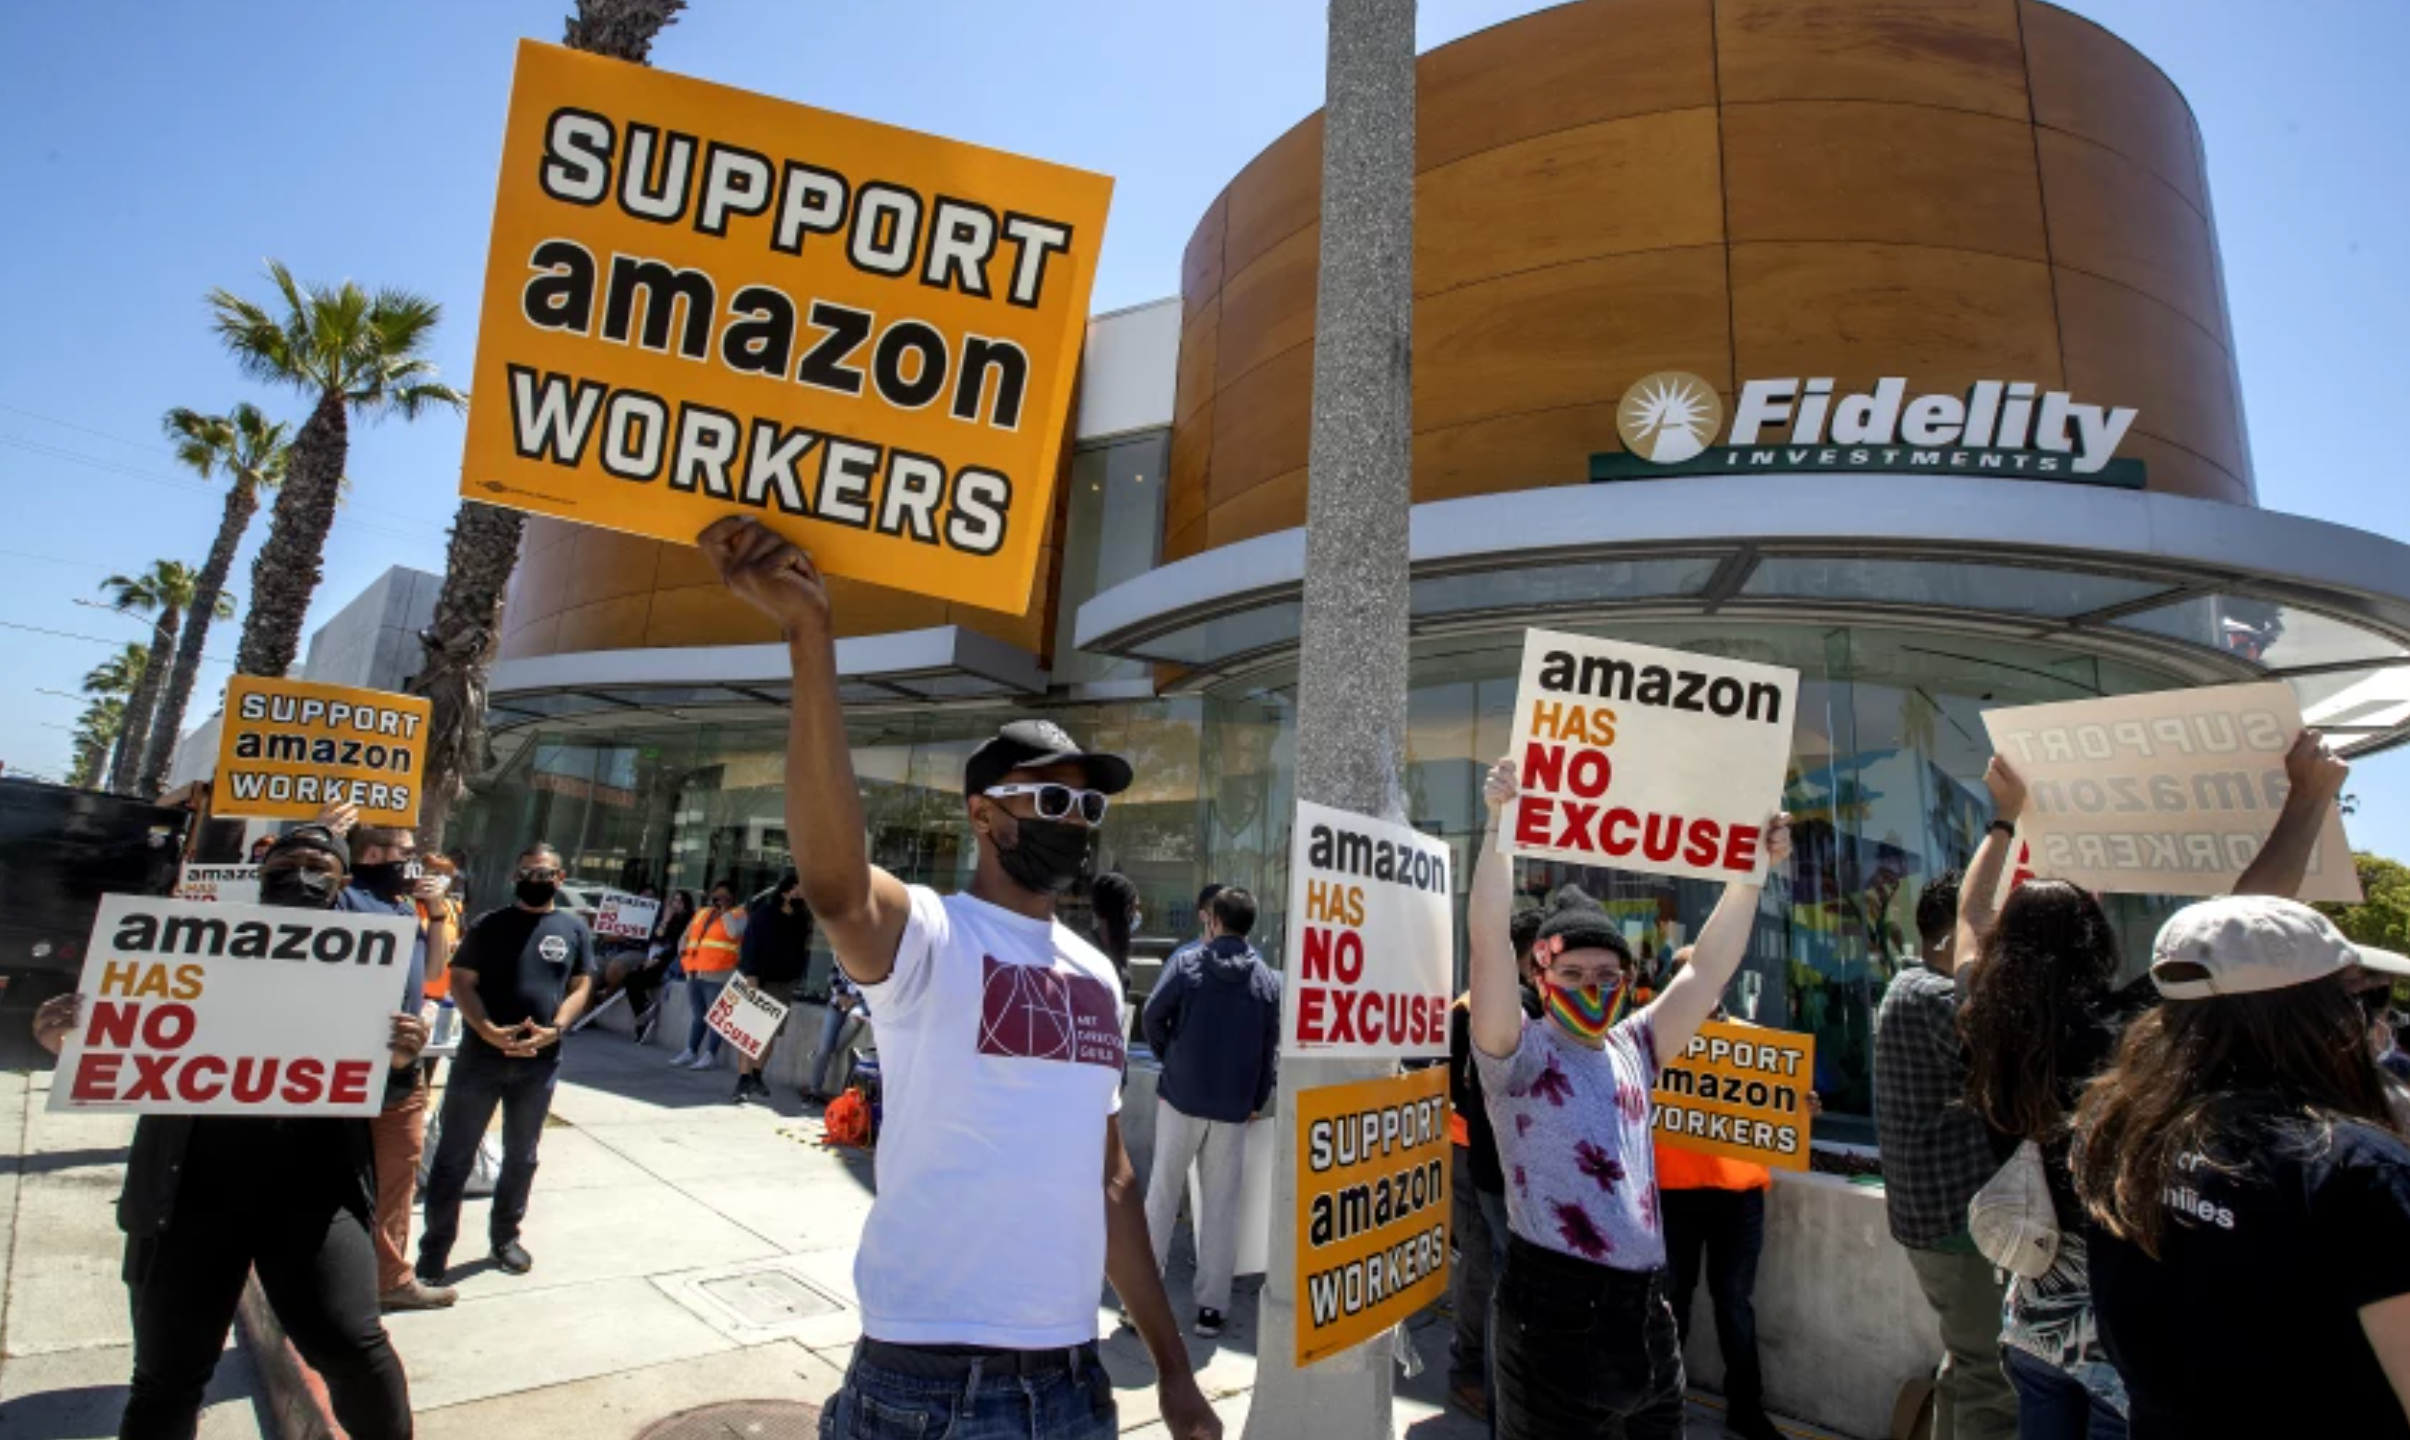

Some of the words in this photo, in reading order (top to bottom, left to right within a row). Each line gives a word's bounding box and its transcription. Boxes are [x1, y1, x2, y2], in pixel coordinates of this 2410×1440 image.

[540, 106, 1073, 310] SUPPORT
[521, 238, 1030, 432] amazon
[1728, 377, 2140, 474] Fidelity
[506, 362, 1012, 557] WORKERS
[1727, 448, 2060, 472] INVESTMENTS
[1539, 650, 1781, 723] amazon
[241, 693, 421, 739] SUPPORT
[1531, 699, 1617, 747] HAS
[236, 732, 411, 773] amazon
[1522, 740, 1612, 799] NO
[230, 771, 409, 811] WORKERS
[1309, 823, 1445, 894] amazon
[1515, 795, 1760, 873] EXCUSE
[188, 868, 259, 881] amazo
[1306, 878, 1365, 928] HAS
[112, 913, 398, 965] amazon
[1302, 926, 1363, 985] NO
[99, 961, 205, 1000] HAS
[84, 1002, 197, 1050] NO
[1296, 987, 1445, 1046] EXCUSE
[69, 1053, 373, 1105] EXCUSE
[1685, 1034, 1804, 1076] PPORT
[1651, 1067, 1796, 1113] mazon
[1310, 1094, 1445, 1172] SUPPORT
[1310, 1158, 1442, 1247] amazon
[1308, 1222, 1444, 1329] WORKERS
